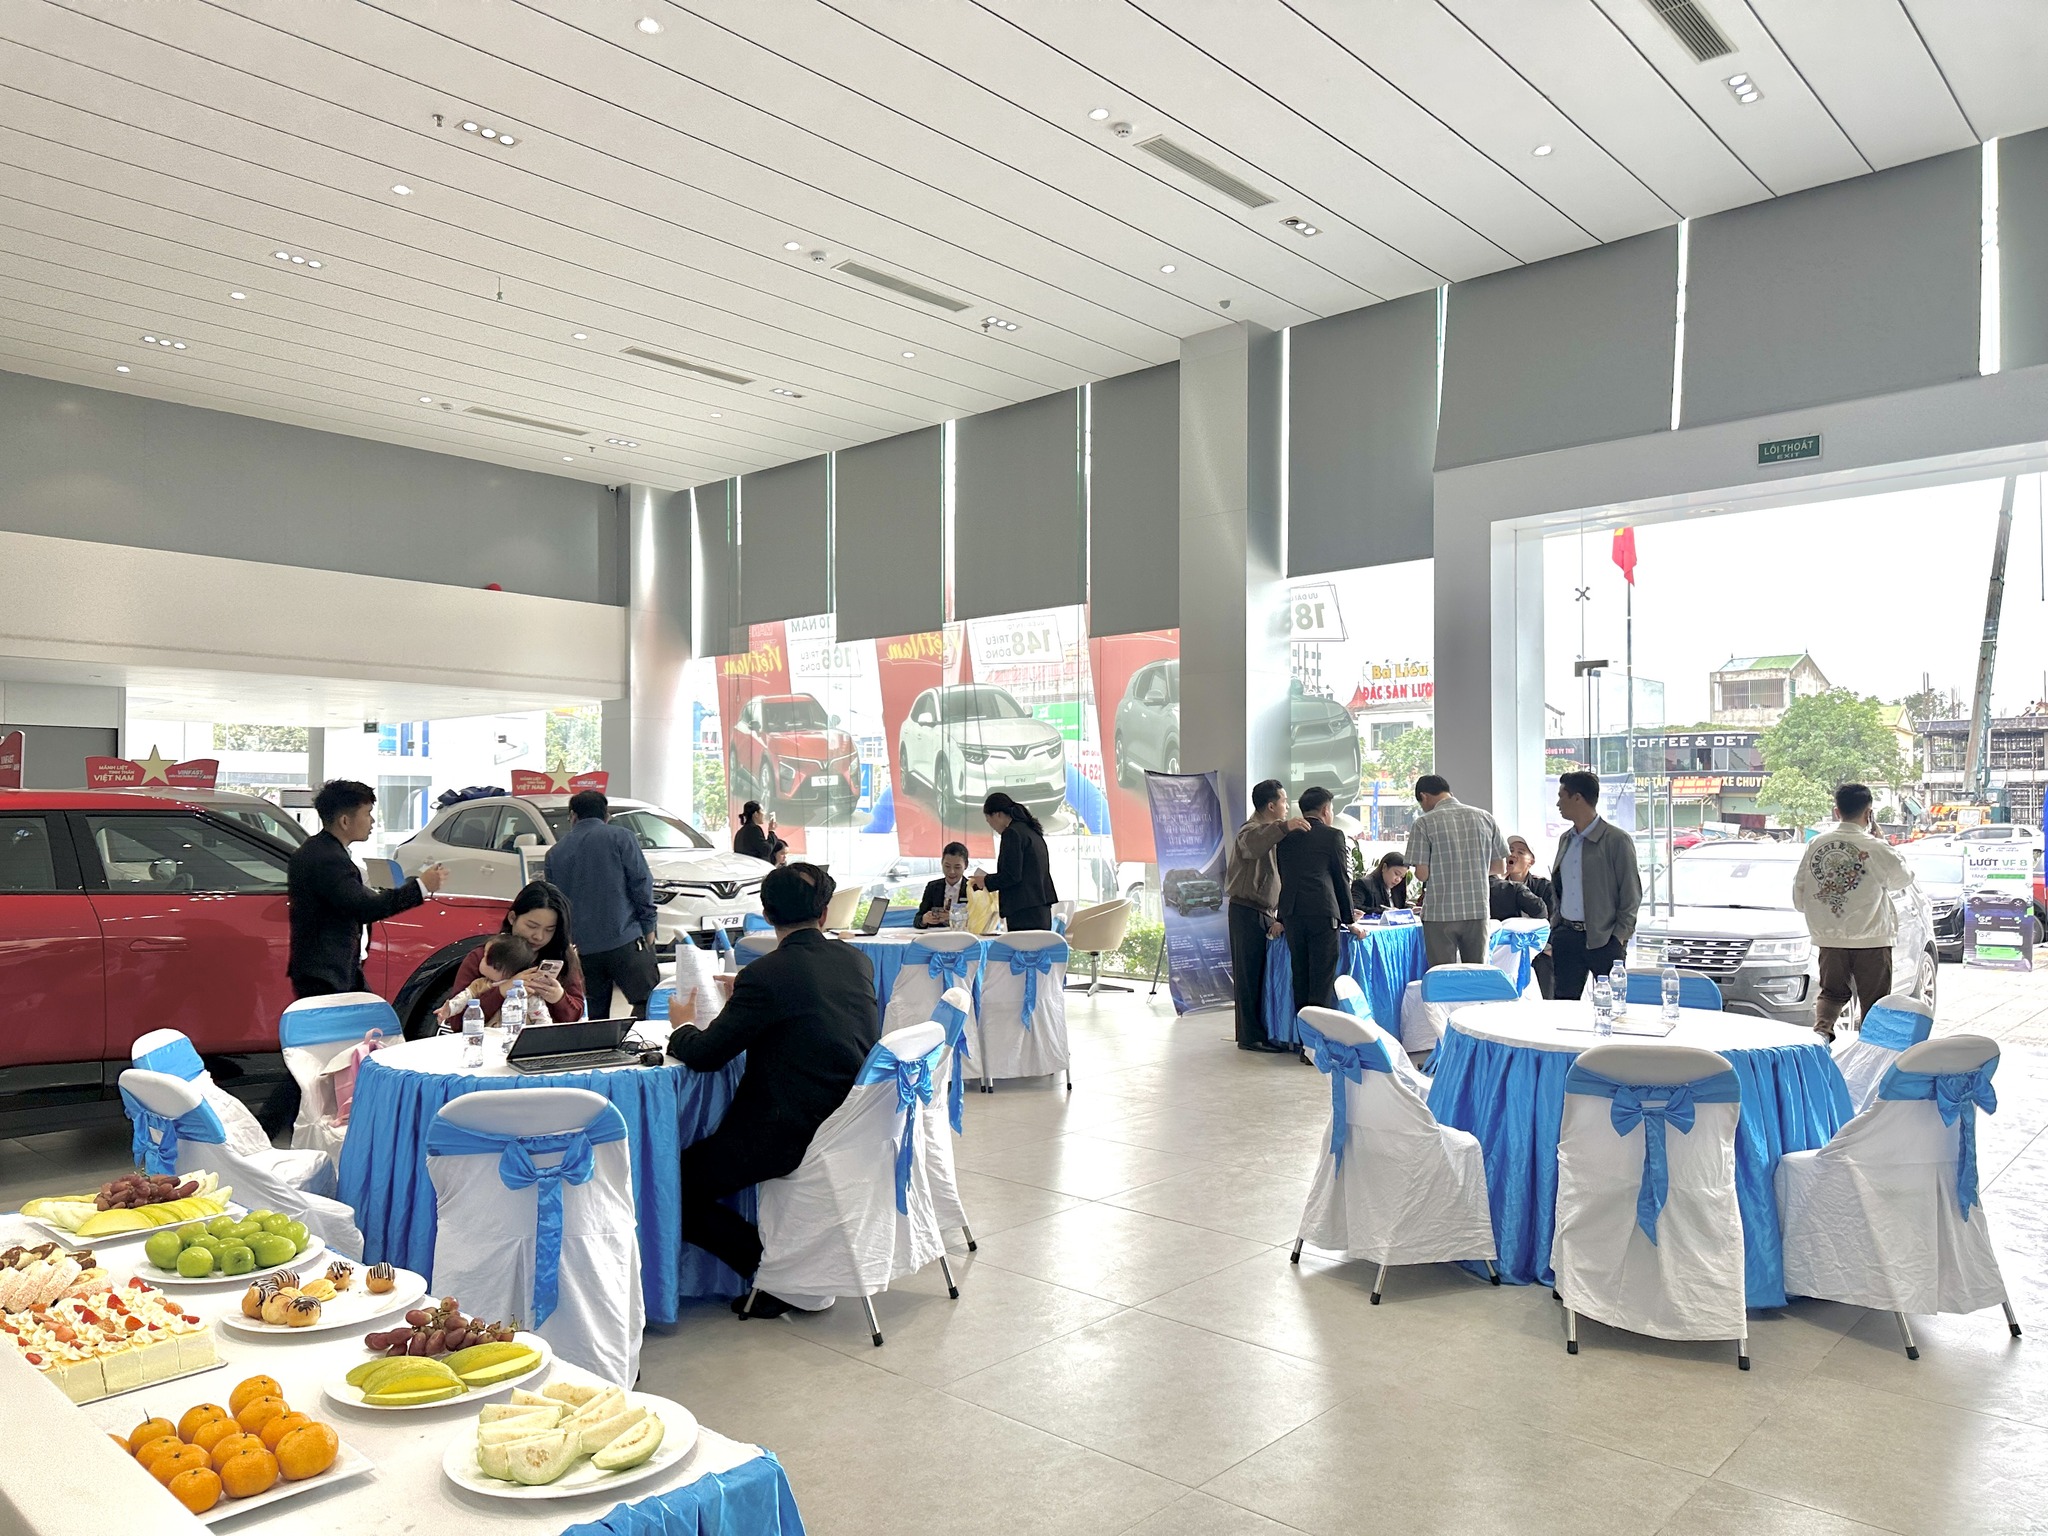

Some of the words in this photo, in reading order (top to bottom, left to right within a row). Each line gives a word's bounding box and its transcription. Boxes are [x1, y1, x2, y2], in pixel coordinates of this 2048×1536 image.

[1781, 439, 1814, 453] THOÁT
[1626, 737, 1689, 748] COFFEE
[1695, 736, 1707, 746] &
[93, 774, 114, 783] VIỆT
[1722, 776, 1734, 787] XE
[2001, 859, 2016, 867] VF
[2020, 859, 2028, 867] 8
